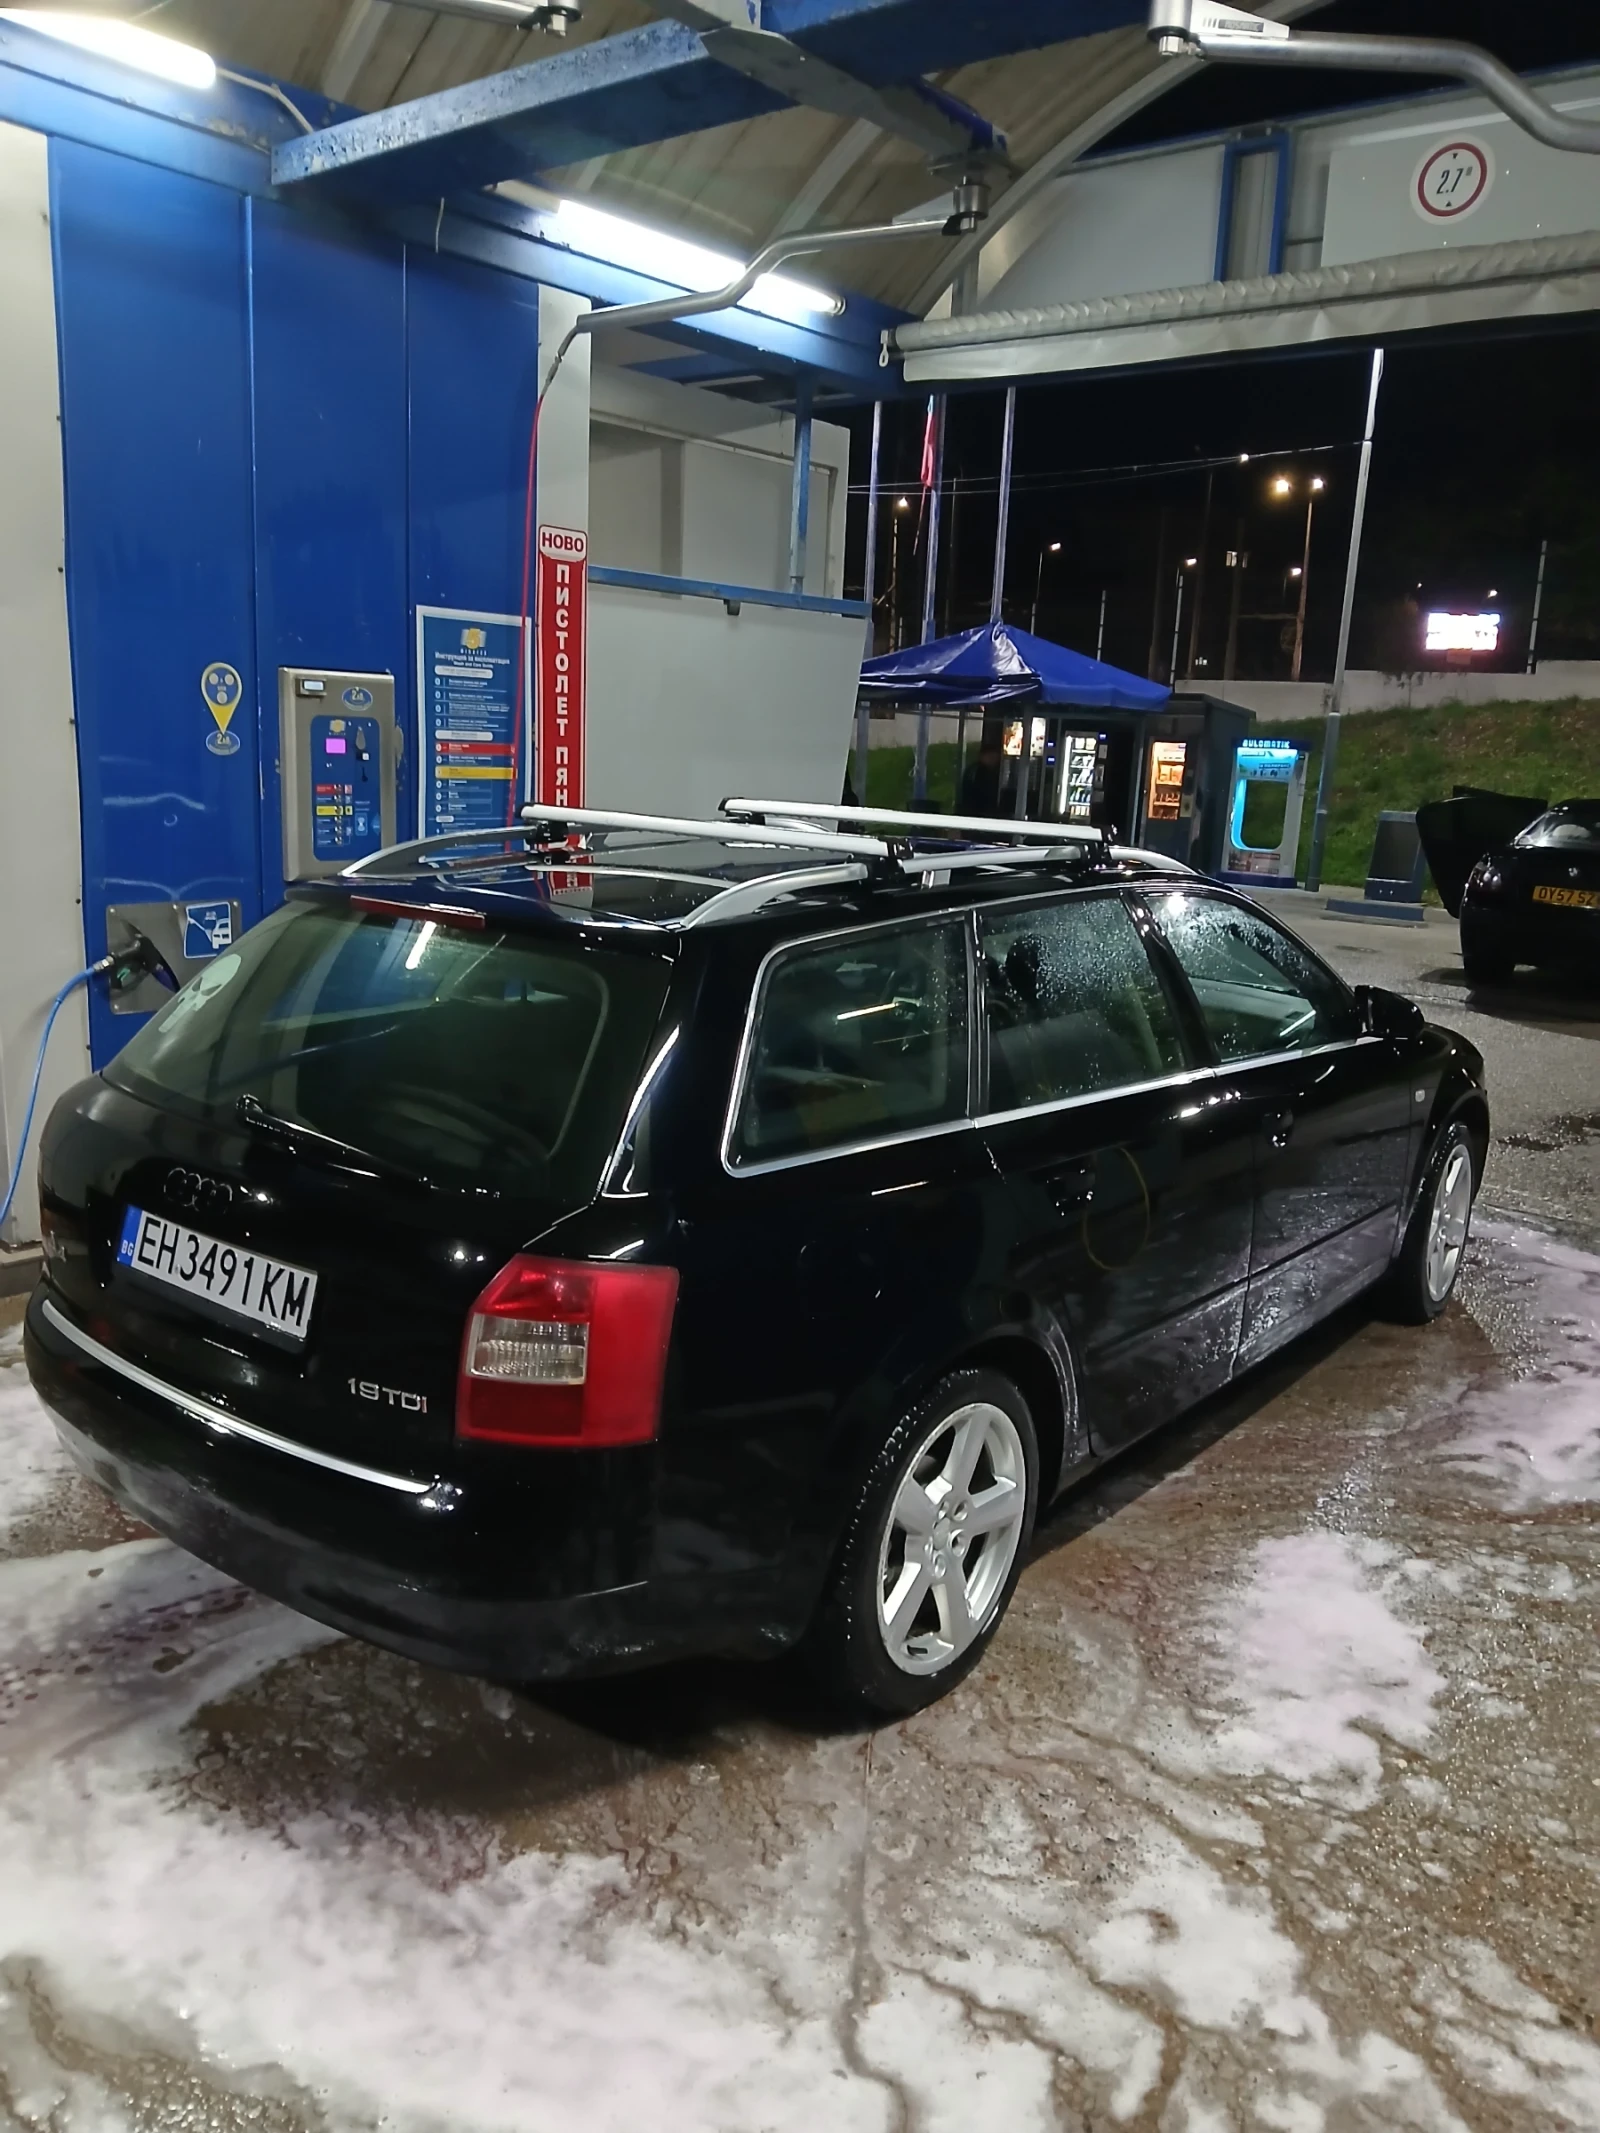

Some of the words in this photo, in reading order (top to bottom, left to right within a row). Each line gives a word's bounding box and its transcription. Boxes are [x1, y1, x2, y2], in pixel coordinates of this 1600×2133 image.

[542, 532, 584, 552] НОВО
[555, 564, 569, 737] ПИСТОЛЕТ
[555, 746, 569, 807] ПЯН
[1577, 891, 1599, 906] SZ
[121, 1239, 135, 1255] BG
